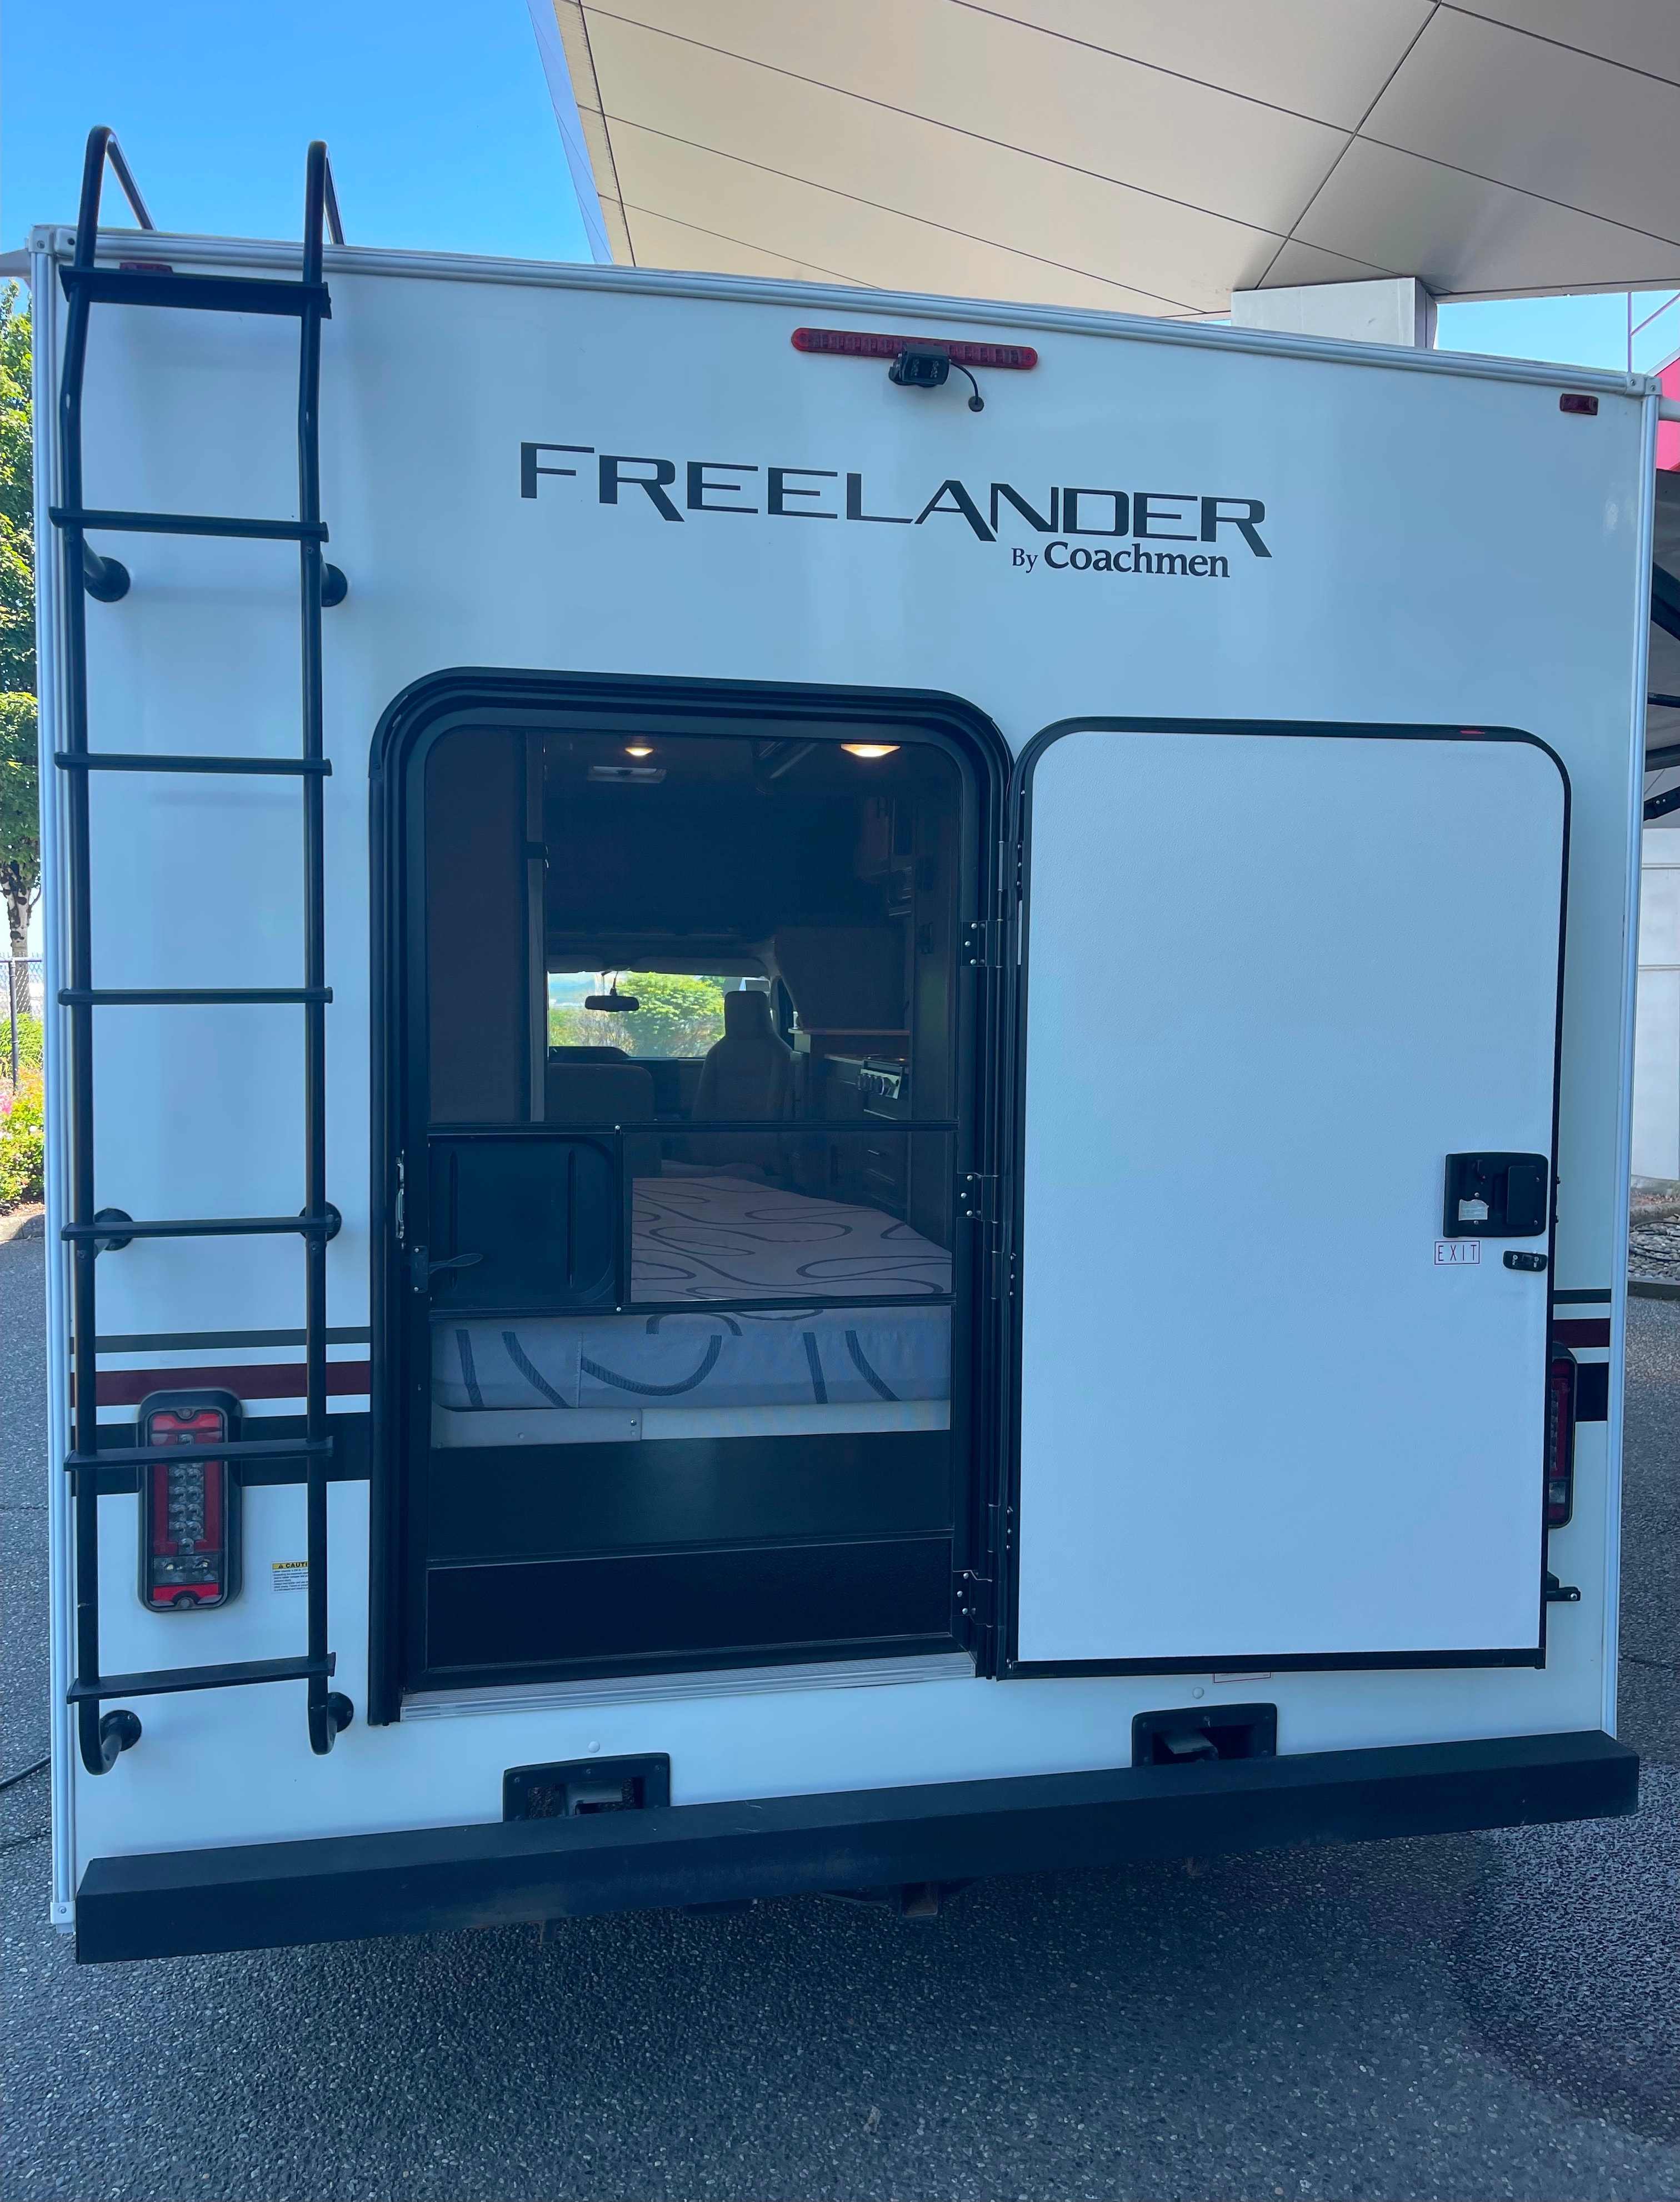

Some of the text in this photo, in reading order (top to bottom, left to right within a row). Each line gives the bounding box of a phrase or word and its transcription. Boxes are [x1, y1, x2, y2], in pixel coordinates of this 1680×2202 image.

[521, 442, 1273, 558] FREELANDER
[1011, 541, 1231, 578] By Coachmen
[1438, 1245, 1477, 1261] EXIT
